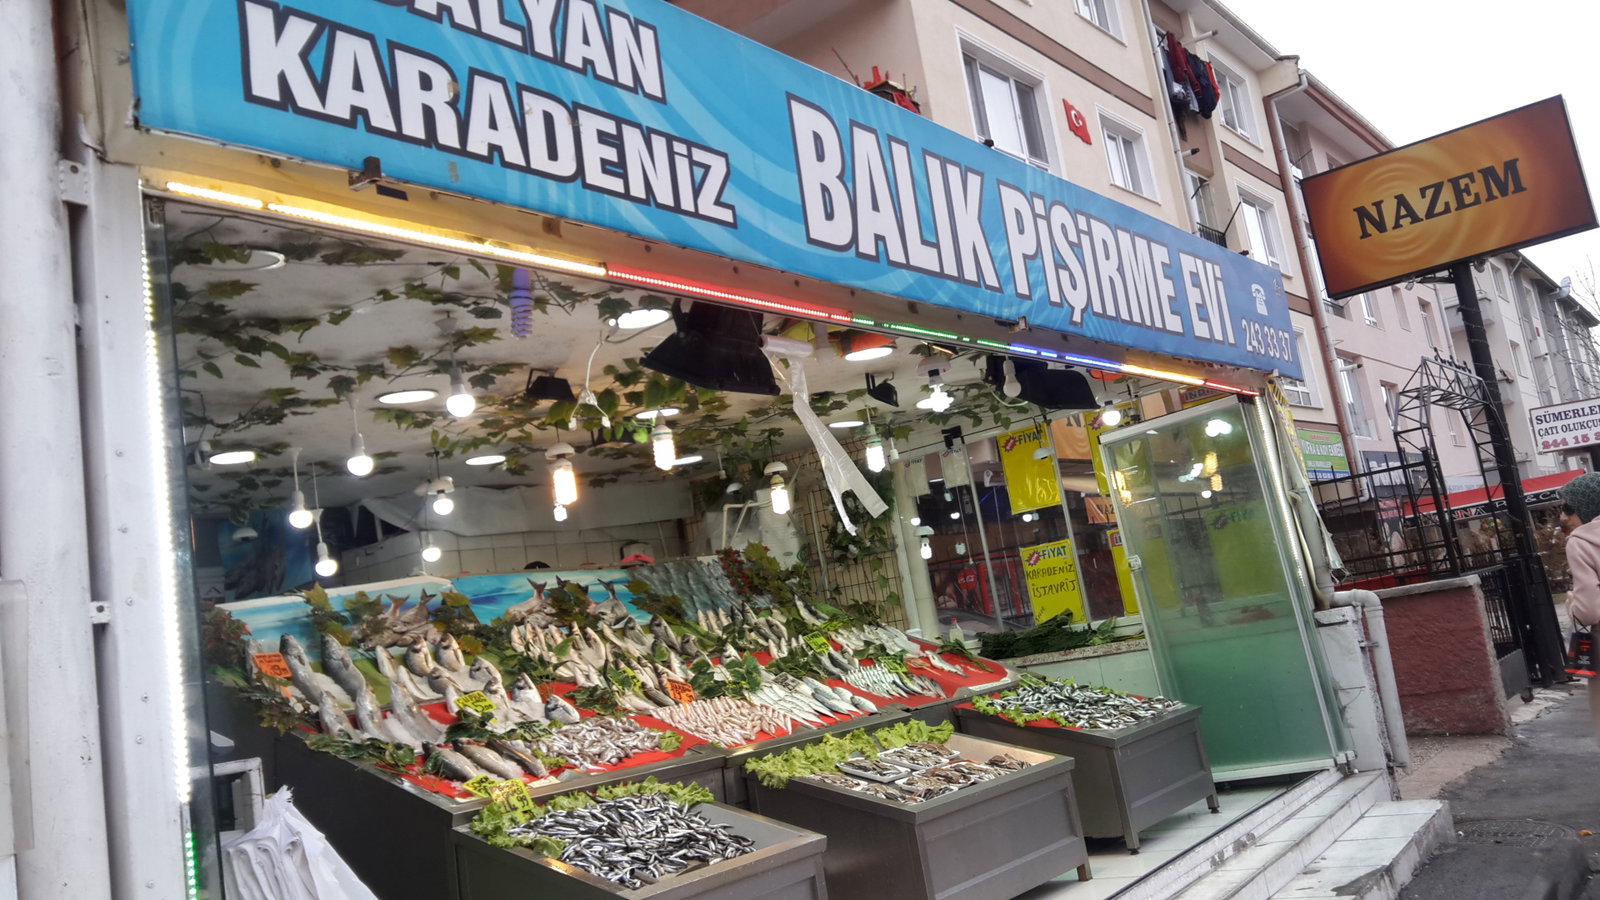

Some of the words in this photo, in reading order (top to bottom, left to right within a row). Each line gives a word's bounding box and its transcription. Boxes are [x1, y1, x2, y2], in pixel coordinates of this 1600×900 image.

[243, 0, 737, 227] KARADENİZ
[786, 92, 1003, 293] BALIK
[998, 178, 1184, 327] PİŞİRME
[1178, 250, 1236, 346] EVİ
[1353, 158, 1527, 239] NAZEM
[1241, 318, 1265, 355] 243
[1264, 325, 1280, 358] 33
[1278, 329, 1293, 362] 37
[1535, 405, 1600, 425] SÜMERLE
[1537, 426, 1559, 440] ÇATI
[1541, 437, 1569, 450] 244
